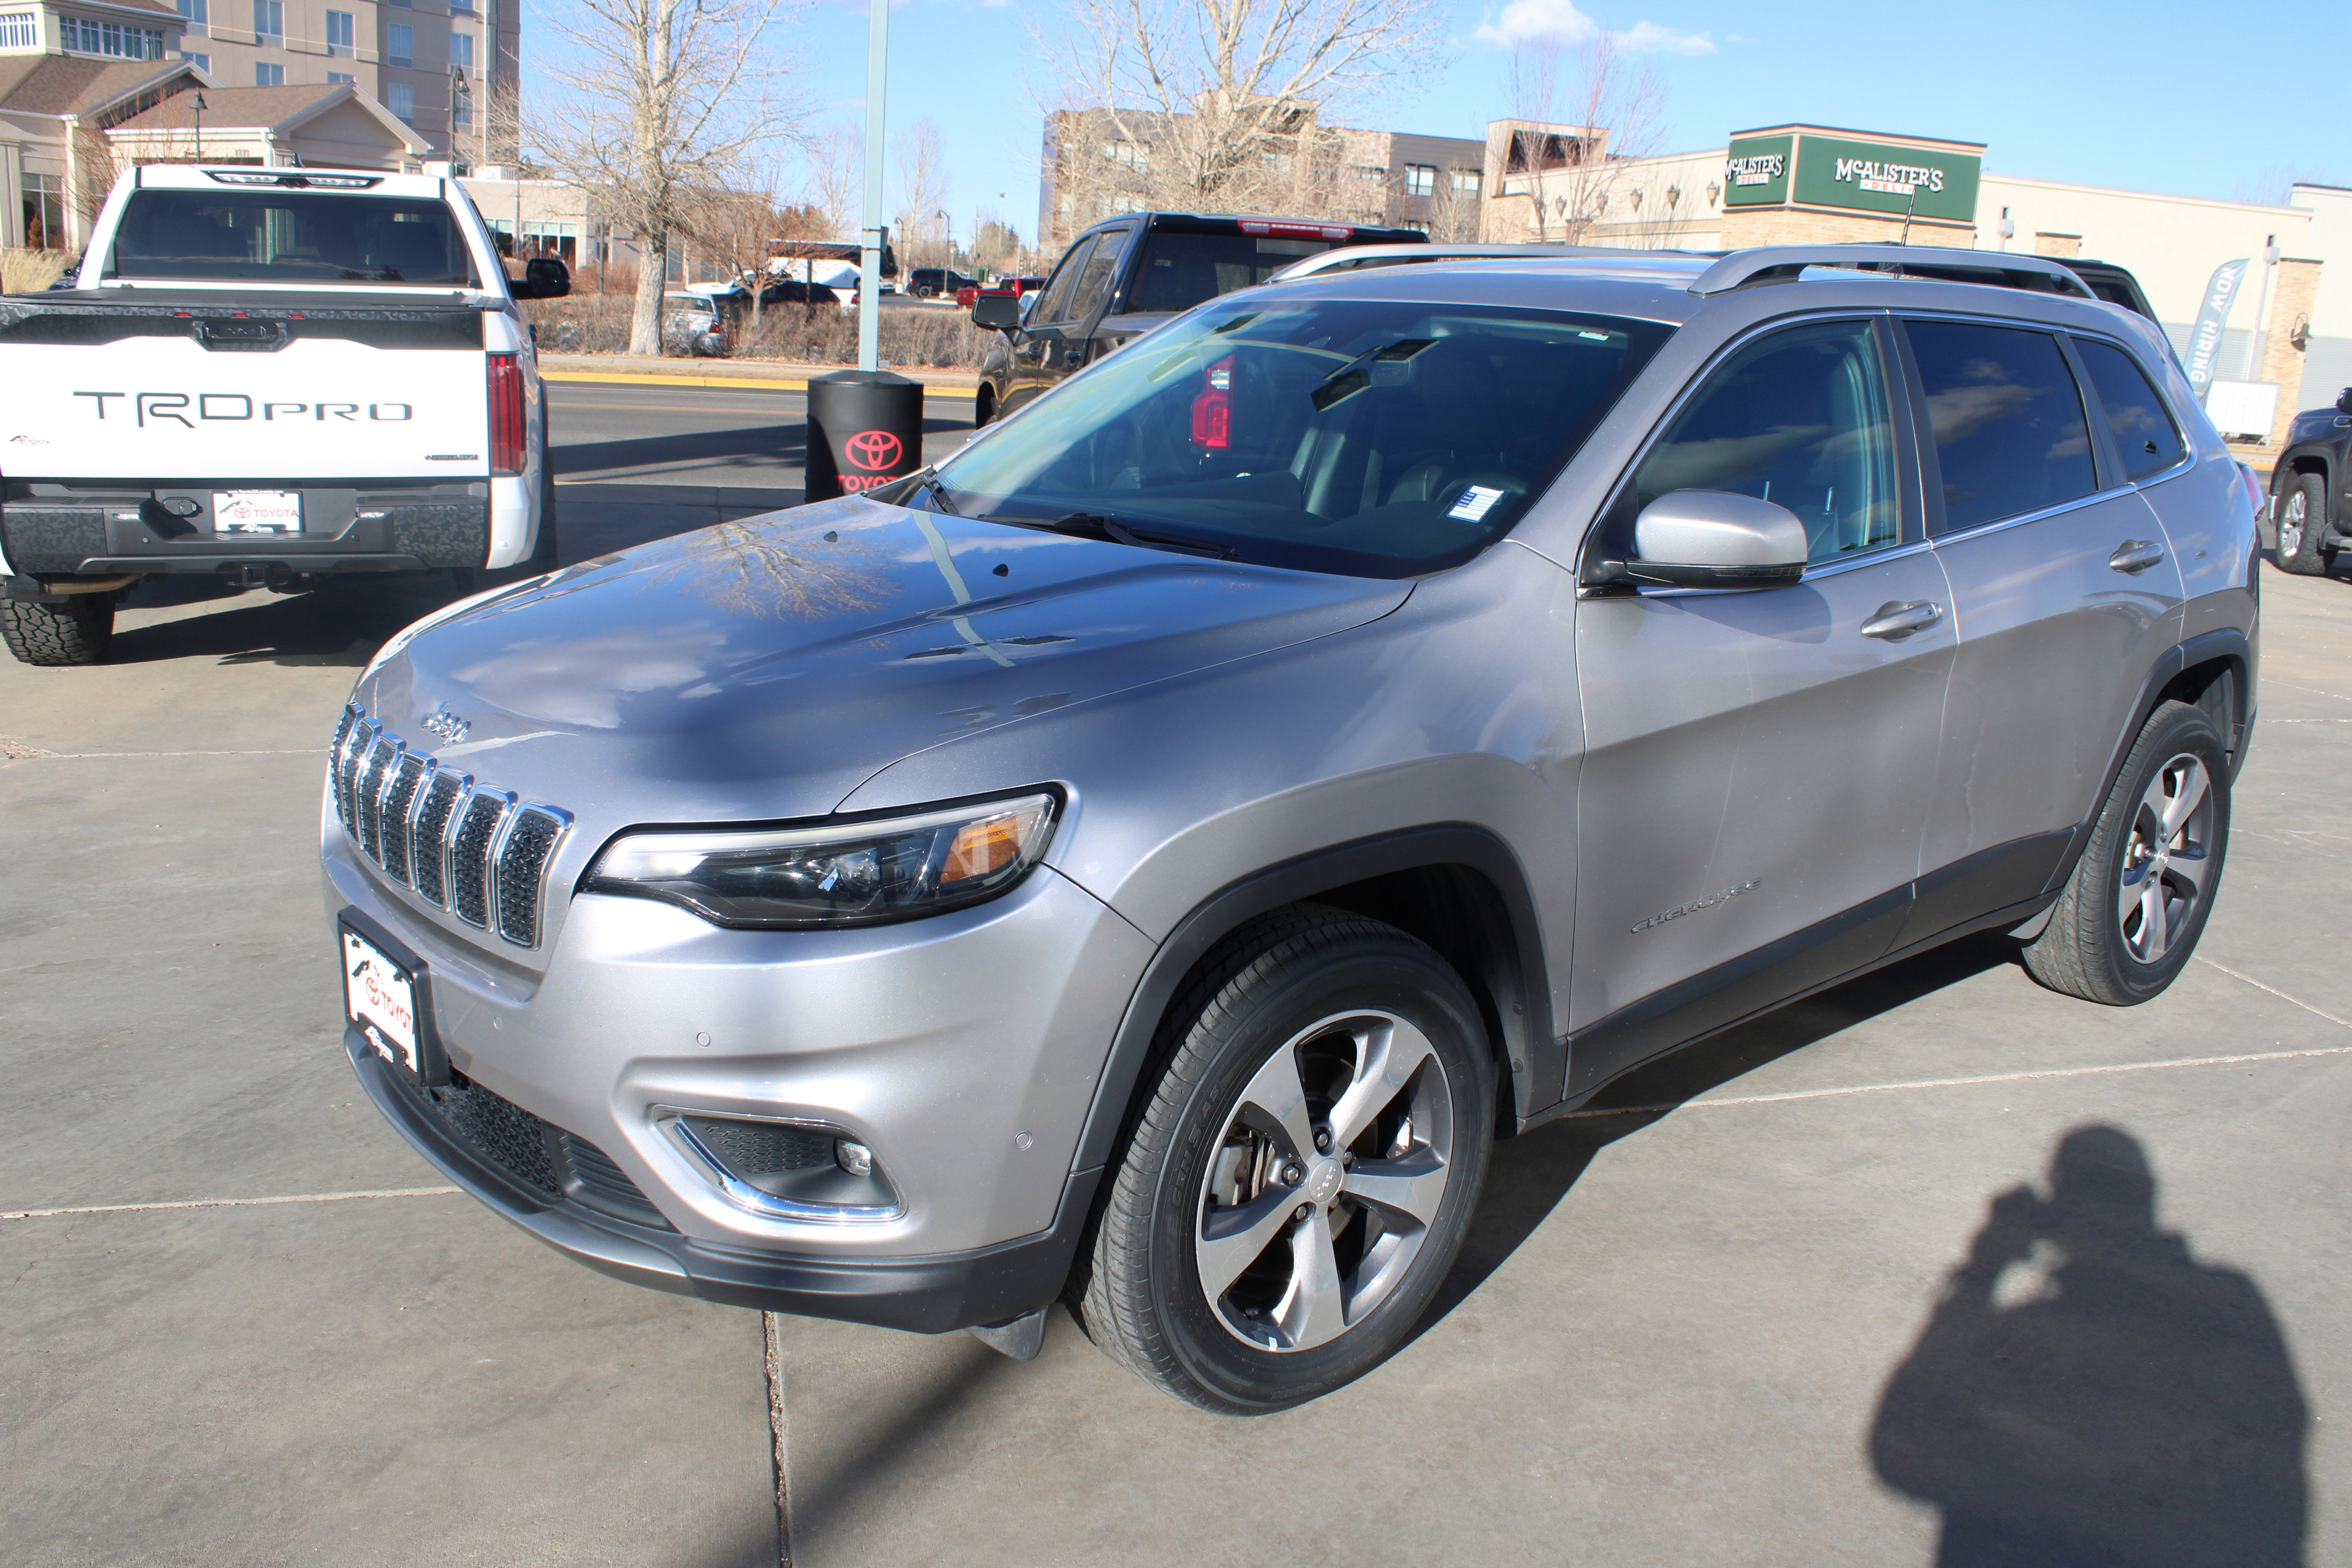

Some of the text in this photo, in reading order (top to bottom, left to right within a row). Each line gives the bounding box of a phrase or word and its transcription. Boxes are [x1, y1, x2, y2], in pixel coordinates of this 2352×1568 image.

[1741, 175, 1760, 184] DELI
[1871, 182, 1904, 192] DELI
[2190, 267, 2237, 383] NOW HIRING
[72, 390, 412, 429] TRD PRO
[834, 474, 899, 491] TOYO
[254, 509, 299, 517] TOYOTA
[381, 991, 412, 1033] TOYOT
[1172, 1149, 1193, 1207] GEN
[1203, 1085, 1220, 1120] AS
